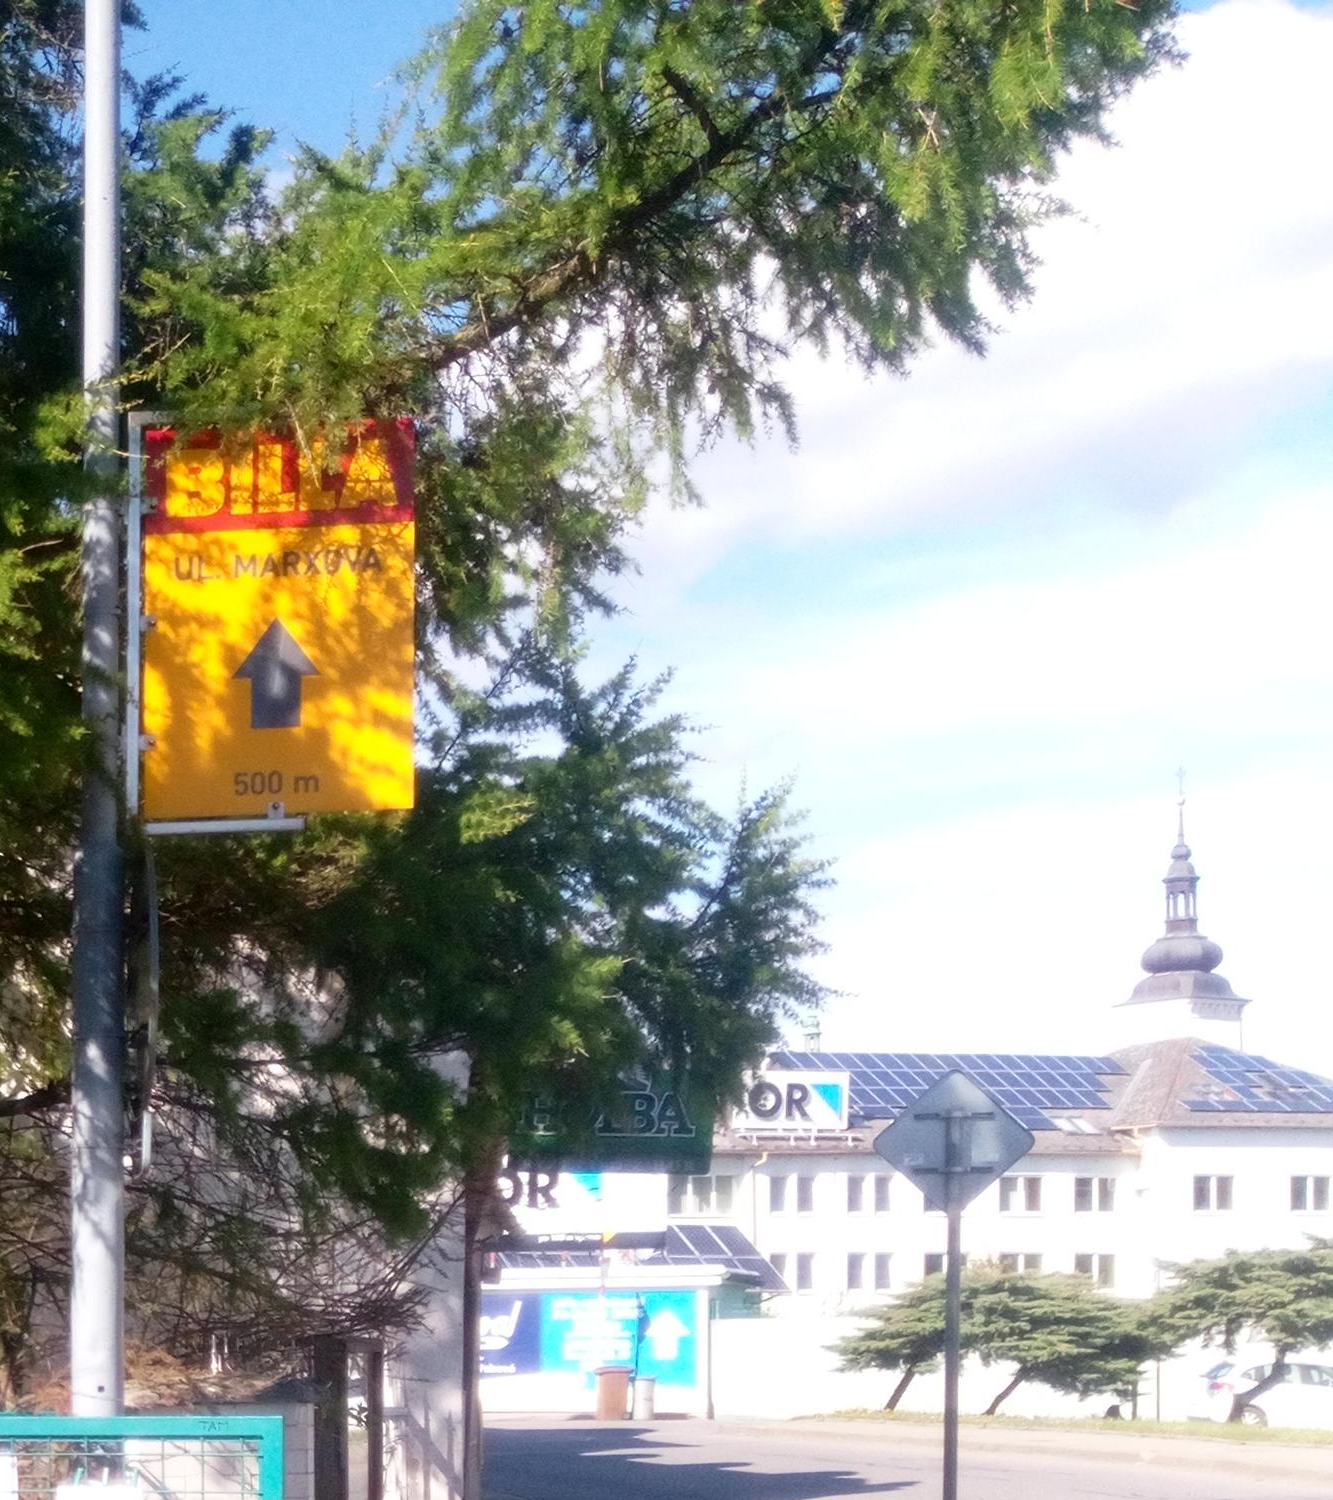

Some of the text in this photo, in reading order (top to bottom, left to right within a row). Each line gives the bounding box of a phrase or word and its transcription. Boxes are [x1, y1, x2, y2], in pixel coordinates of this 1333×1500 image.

[165, 438, 398, 518] BILLA
[175, 546, 383, 583] UL. MARXOVA
[234, 770, 321, 796] 500 m
